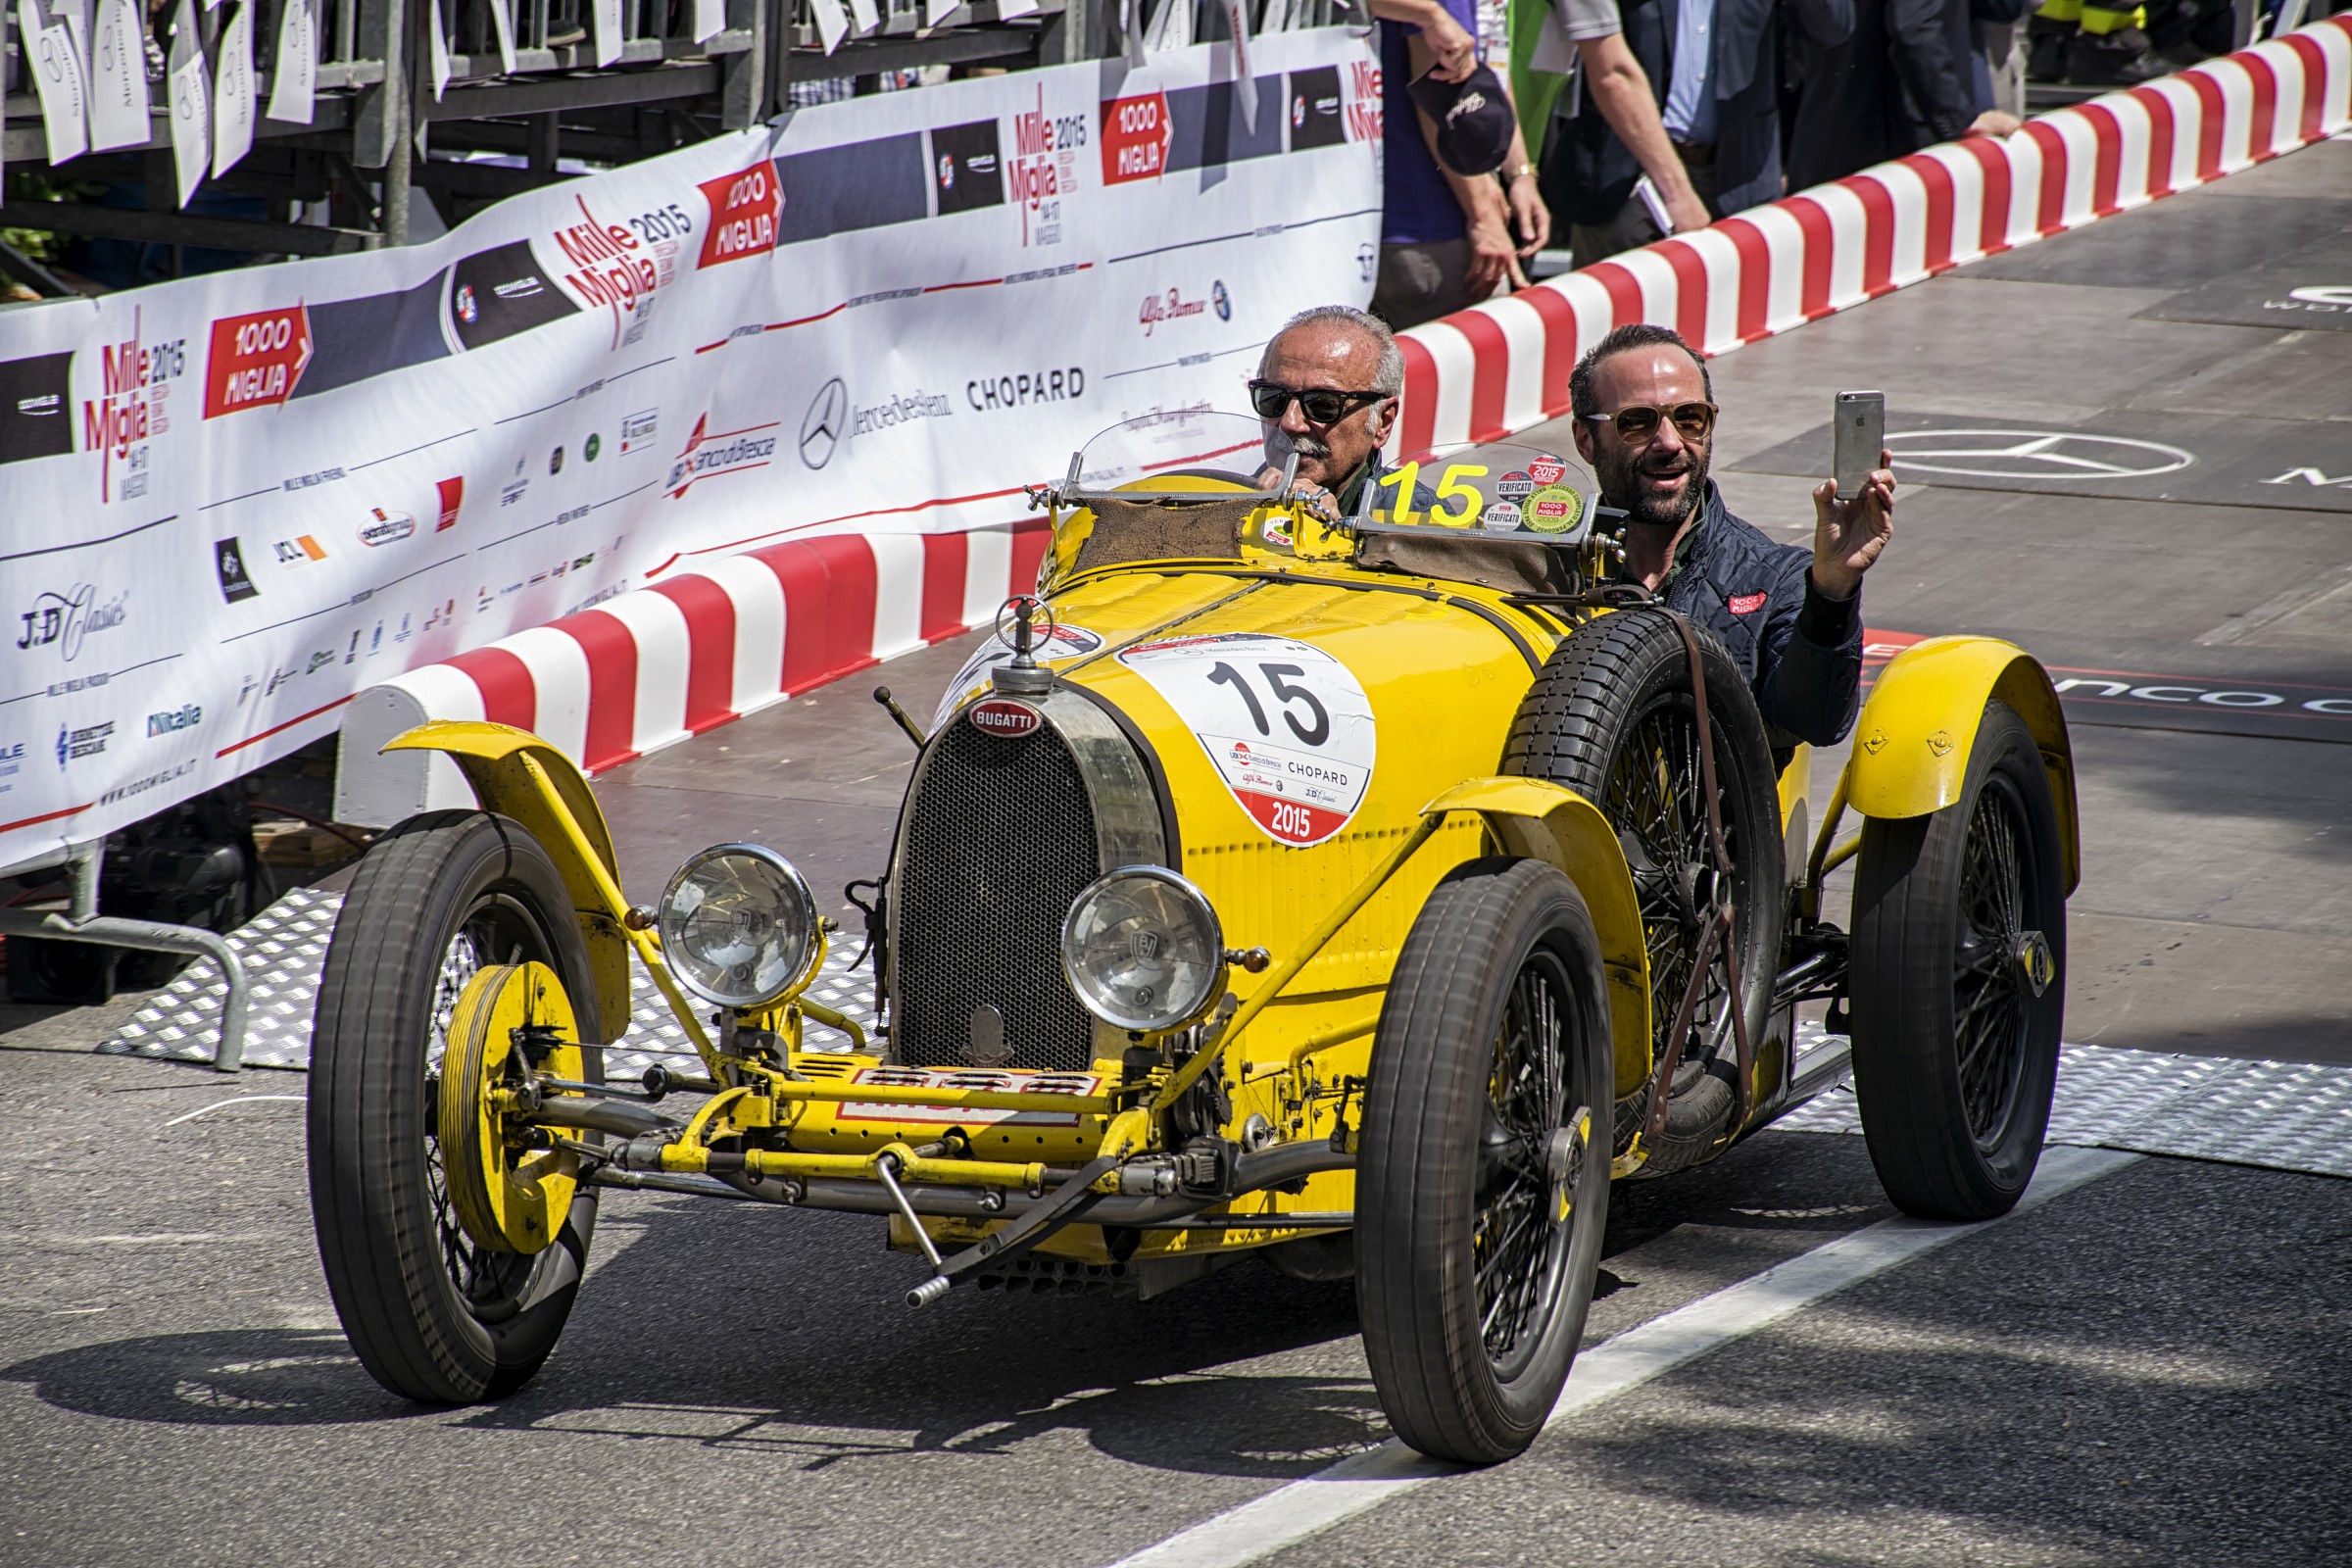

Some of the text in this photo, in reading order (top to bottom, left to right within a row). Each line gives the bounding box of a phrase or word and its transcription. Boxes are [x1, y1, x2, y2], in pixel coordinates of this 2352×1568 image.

[1015, 81, 1087, 156] Mille 2015
[1119, 101, 1157, 134] 1000
[1118, 141, 1160, 176] MIGLIA
[725, 171, 766, 212] 1000
[1007, 154, 1057, 248] Miglia
[554, 193, 640, 269] Mille
[629, 204, 692, 243] 2015
[714, 214, 773, 257] MIGLIA
[564, 254, 657, 351] Miglia
[102, 305, 187, 396] Mille 2015
[235, 318, 292, 357] 1000
[223, 364, 287, 406] MIGLIA
[966, 368, 1085, 413] CHOPARD
[83, 392, 149, 504] Miglia
[1498, 481, 1532, 493] VERIFICATO
[1534, 466, 1559, 478] 2015
[1380, 461, 1489, 526] 15
[1487, 513, 1520, 523] VERIFICATO
[1206, 661, 1330, 747] 15
[2052, 678, 2284, 707] nco
[976, 711, 1032, 729] BUGATTI
[1288, 761, 1348, 786] CHOPARD
[1272, 802, 1310, 838] 2015
